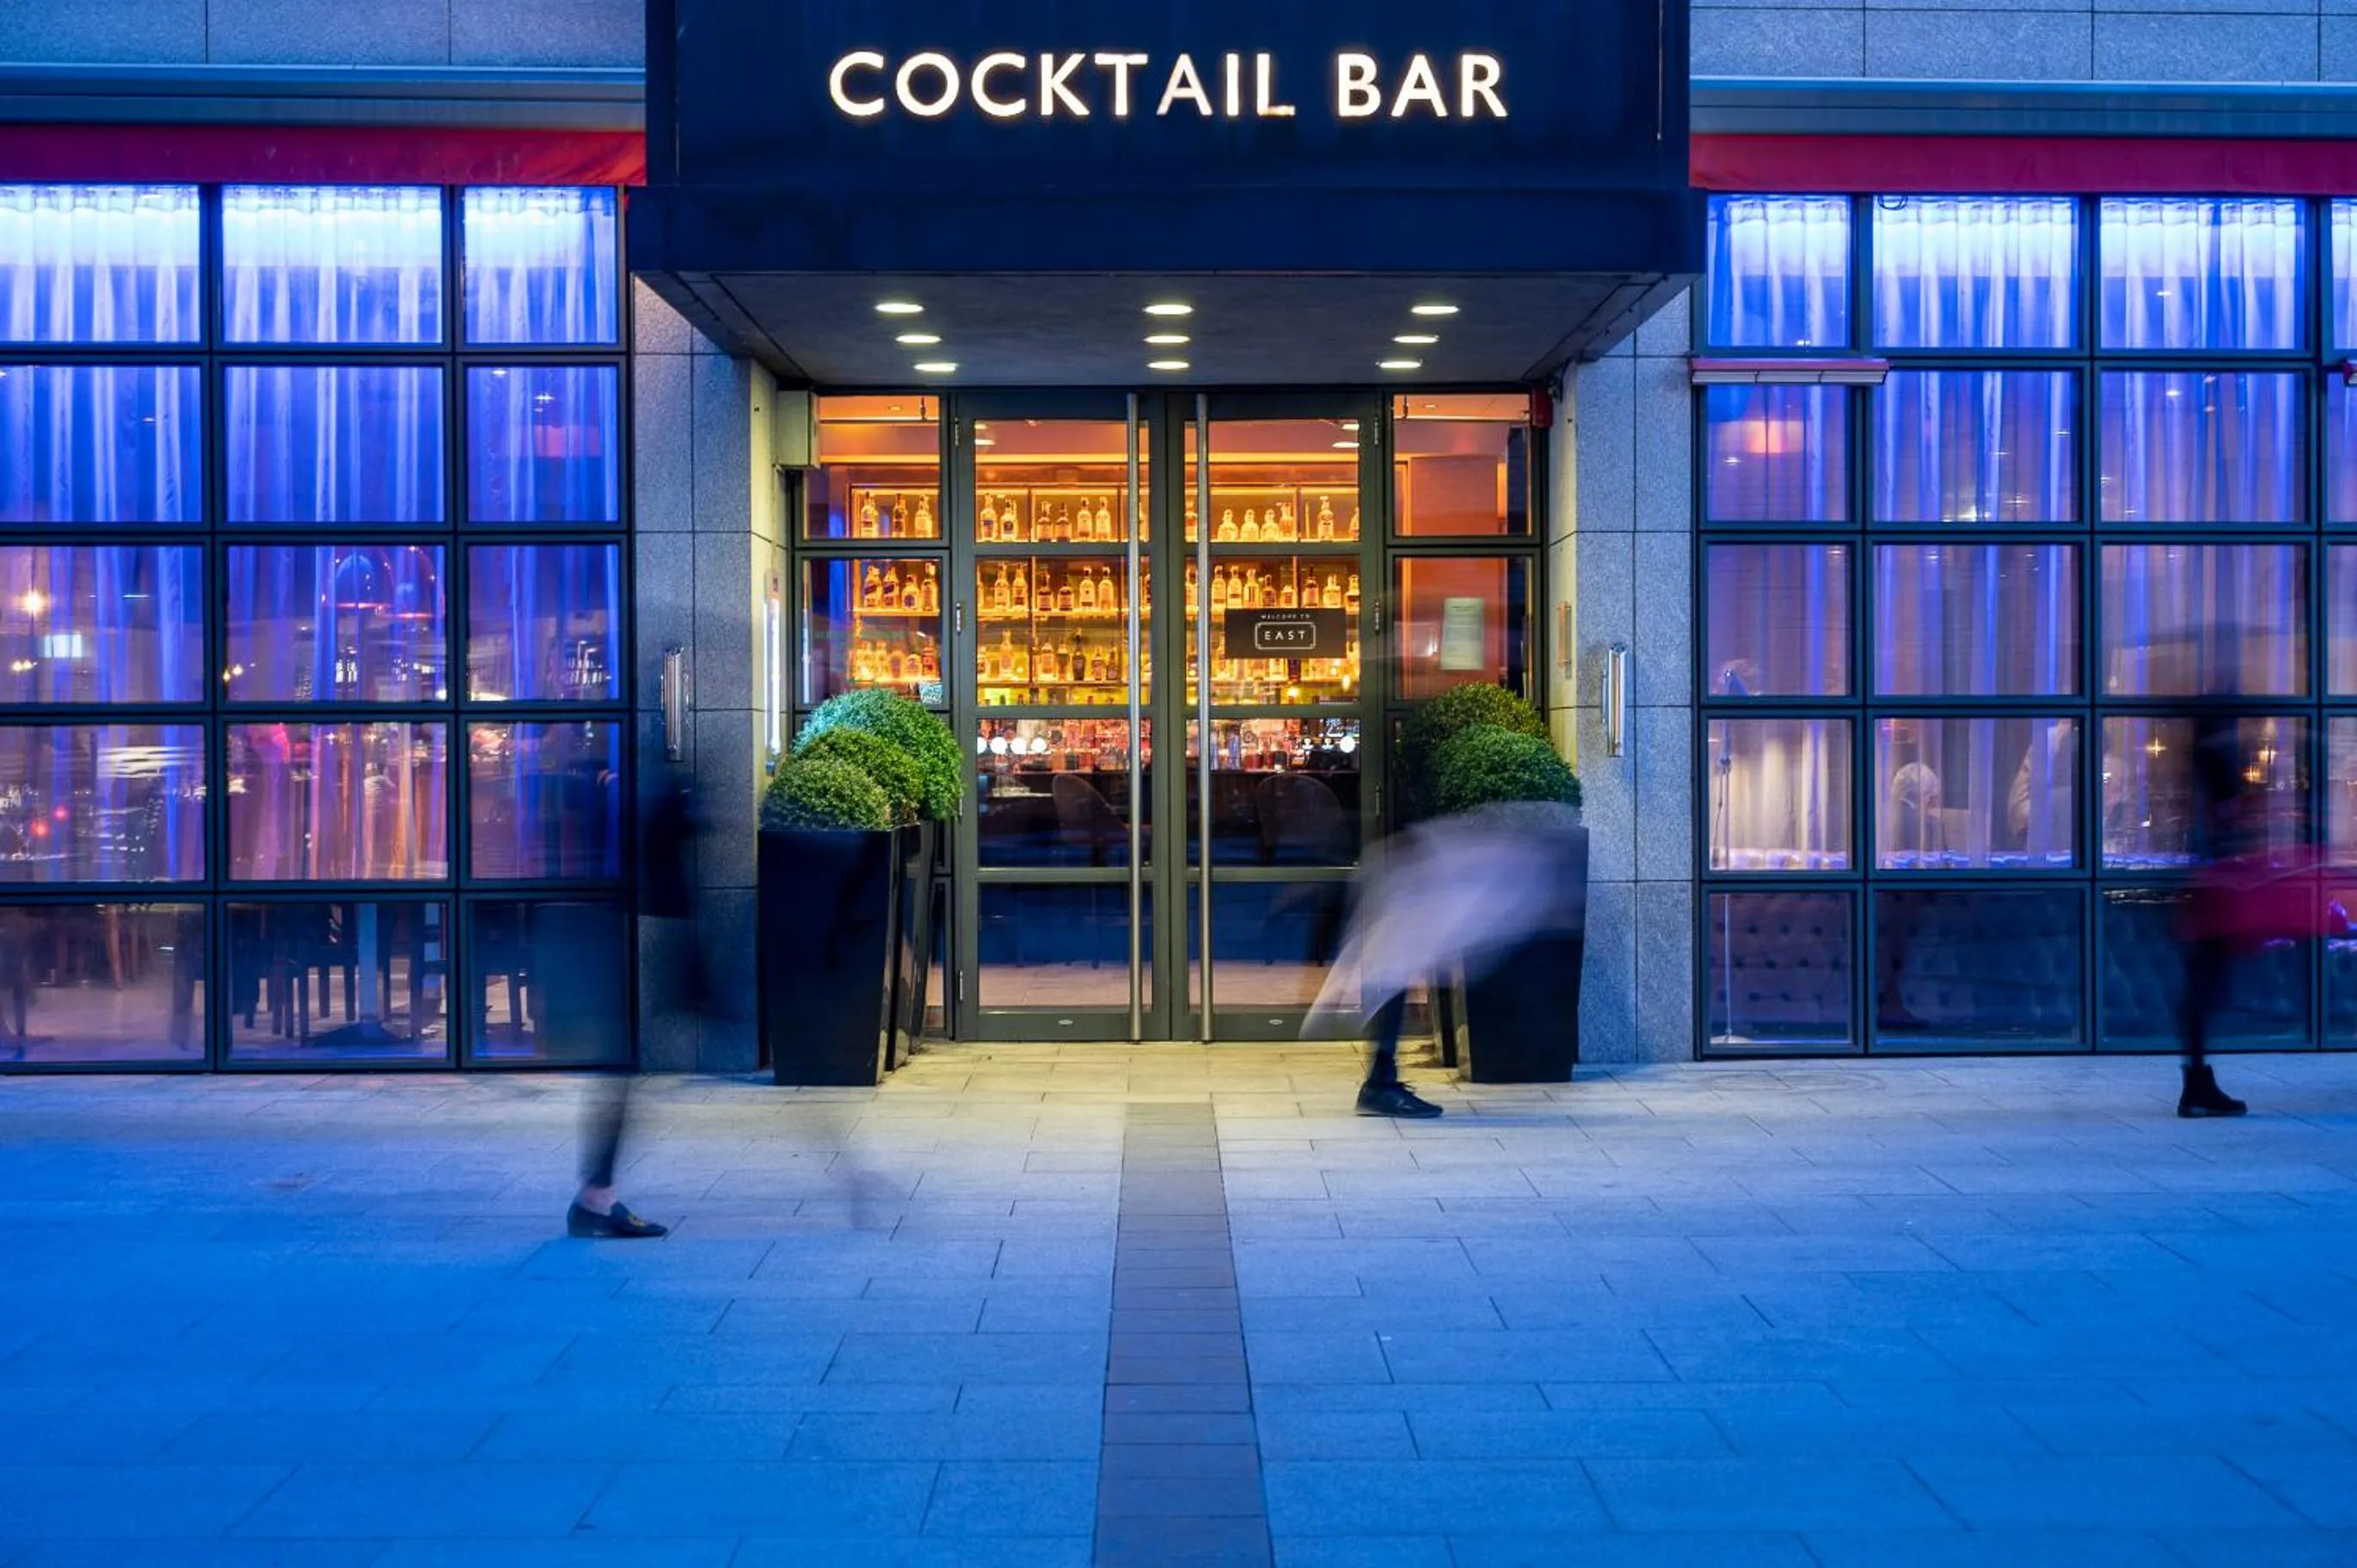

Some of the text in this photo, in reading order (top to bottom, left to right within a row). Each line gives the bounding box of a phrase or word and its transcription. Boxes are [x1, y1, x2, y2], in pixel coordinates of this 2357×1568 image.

[828, 50, 1509, 118] COCKTAIL BAR
[1264, 630, 1305, 640] EAST
